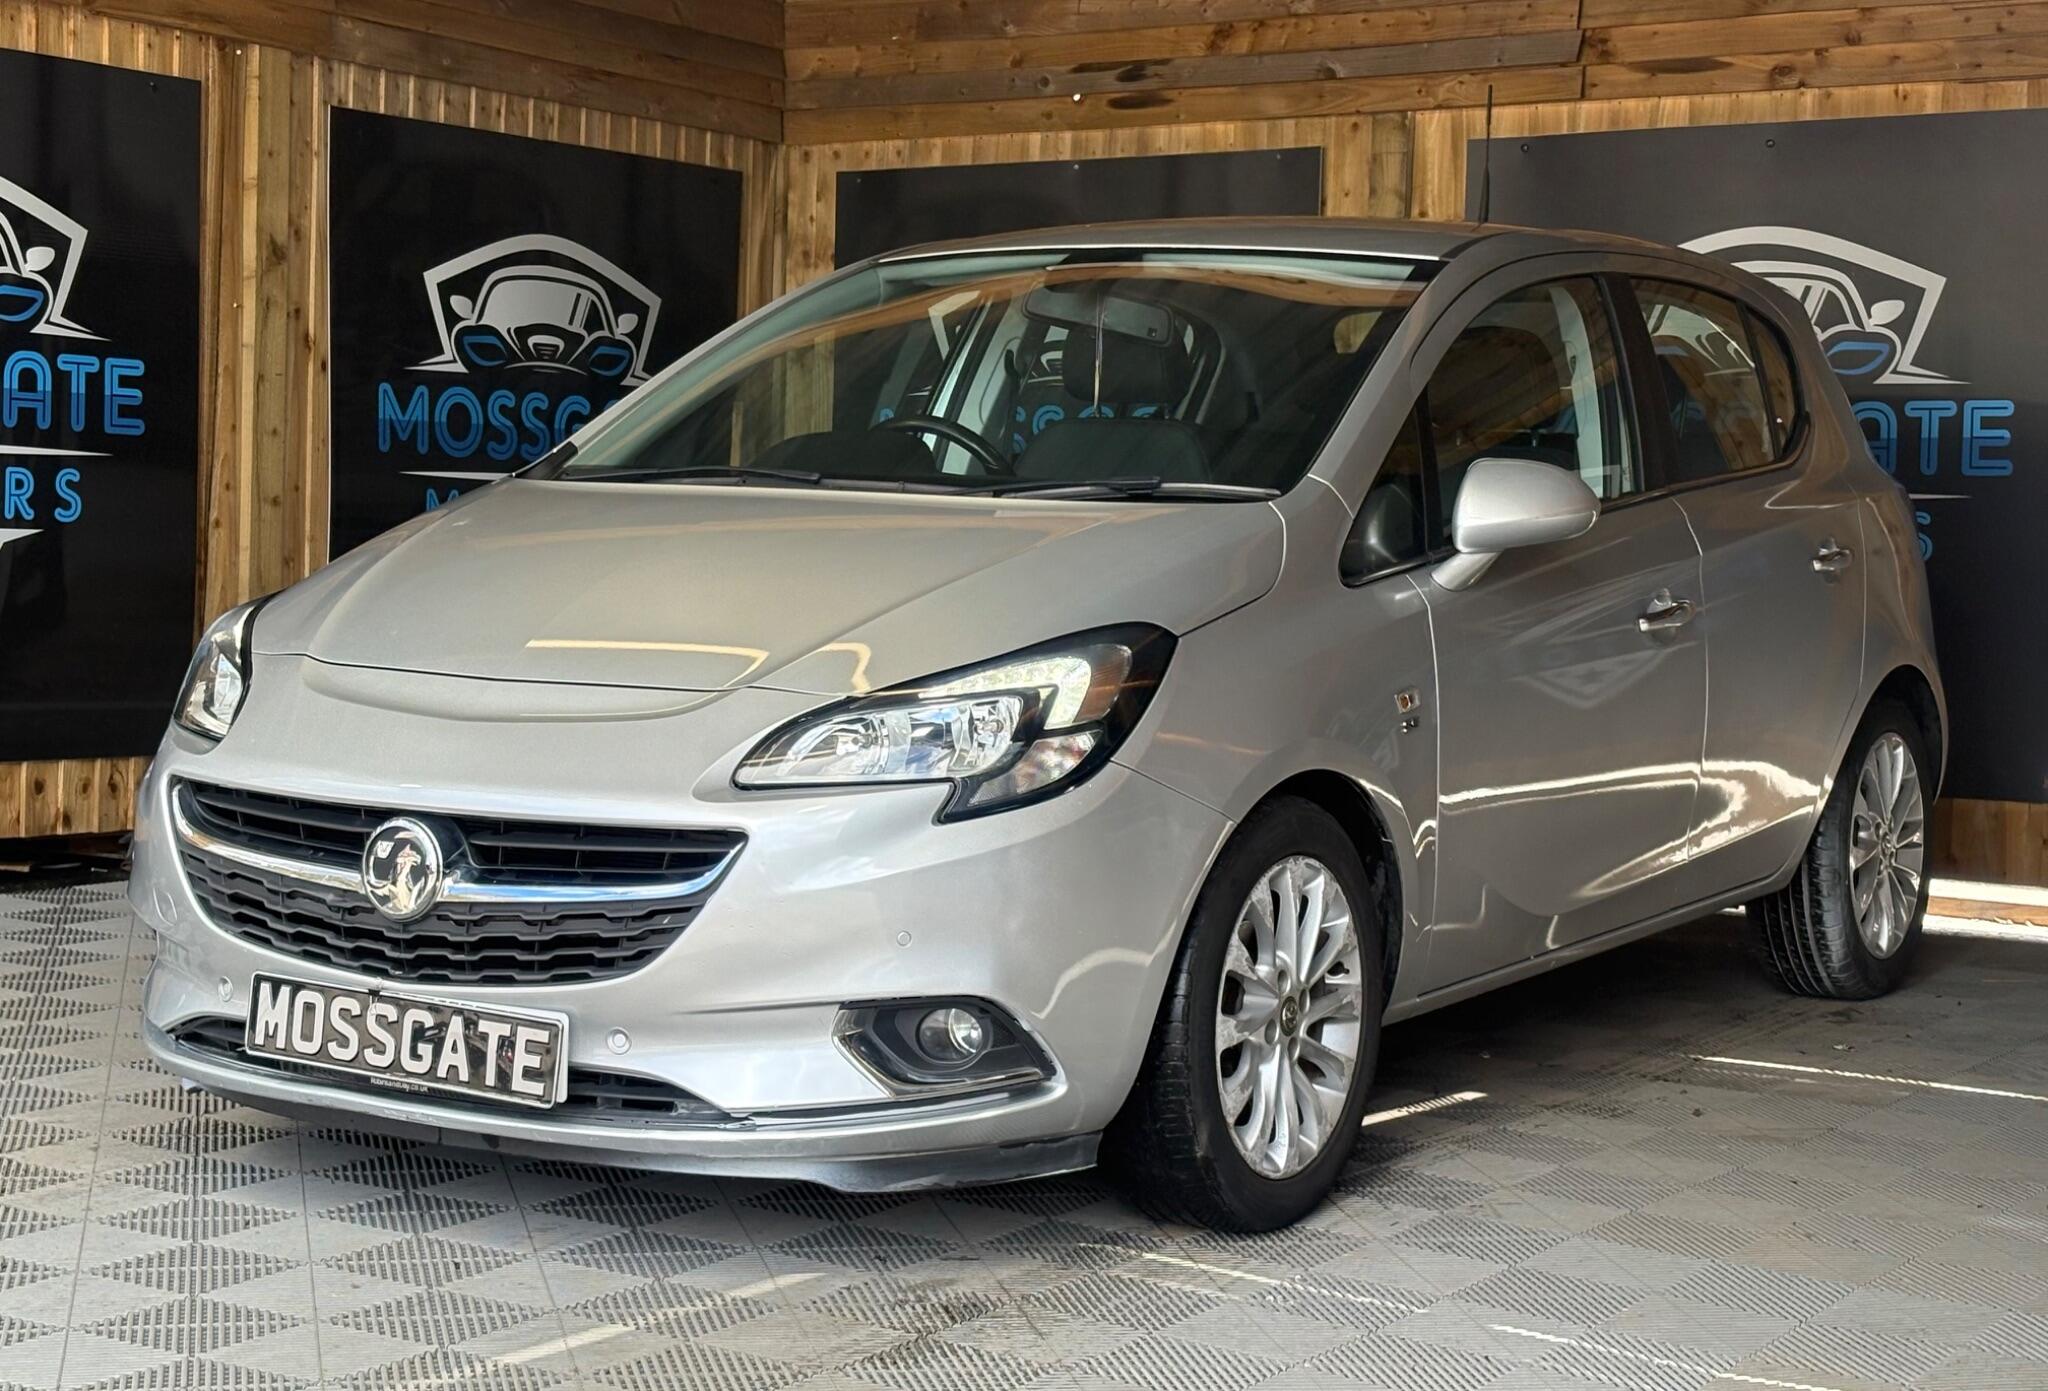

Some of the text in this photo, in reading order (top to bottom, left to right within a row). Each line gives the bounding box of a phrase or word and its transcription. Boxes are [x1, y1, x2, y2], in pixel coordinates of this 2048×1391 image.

[3, 350, 146, 436] ATE
[377, 382, 621, 462] MOSSG
[254, 981, 551, 1097] MOSSGATE
